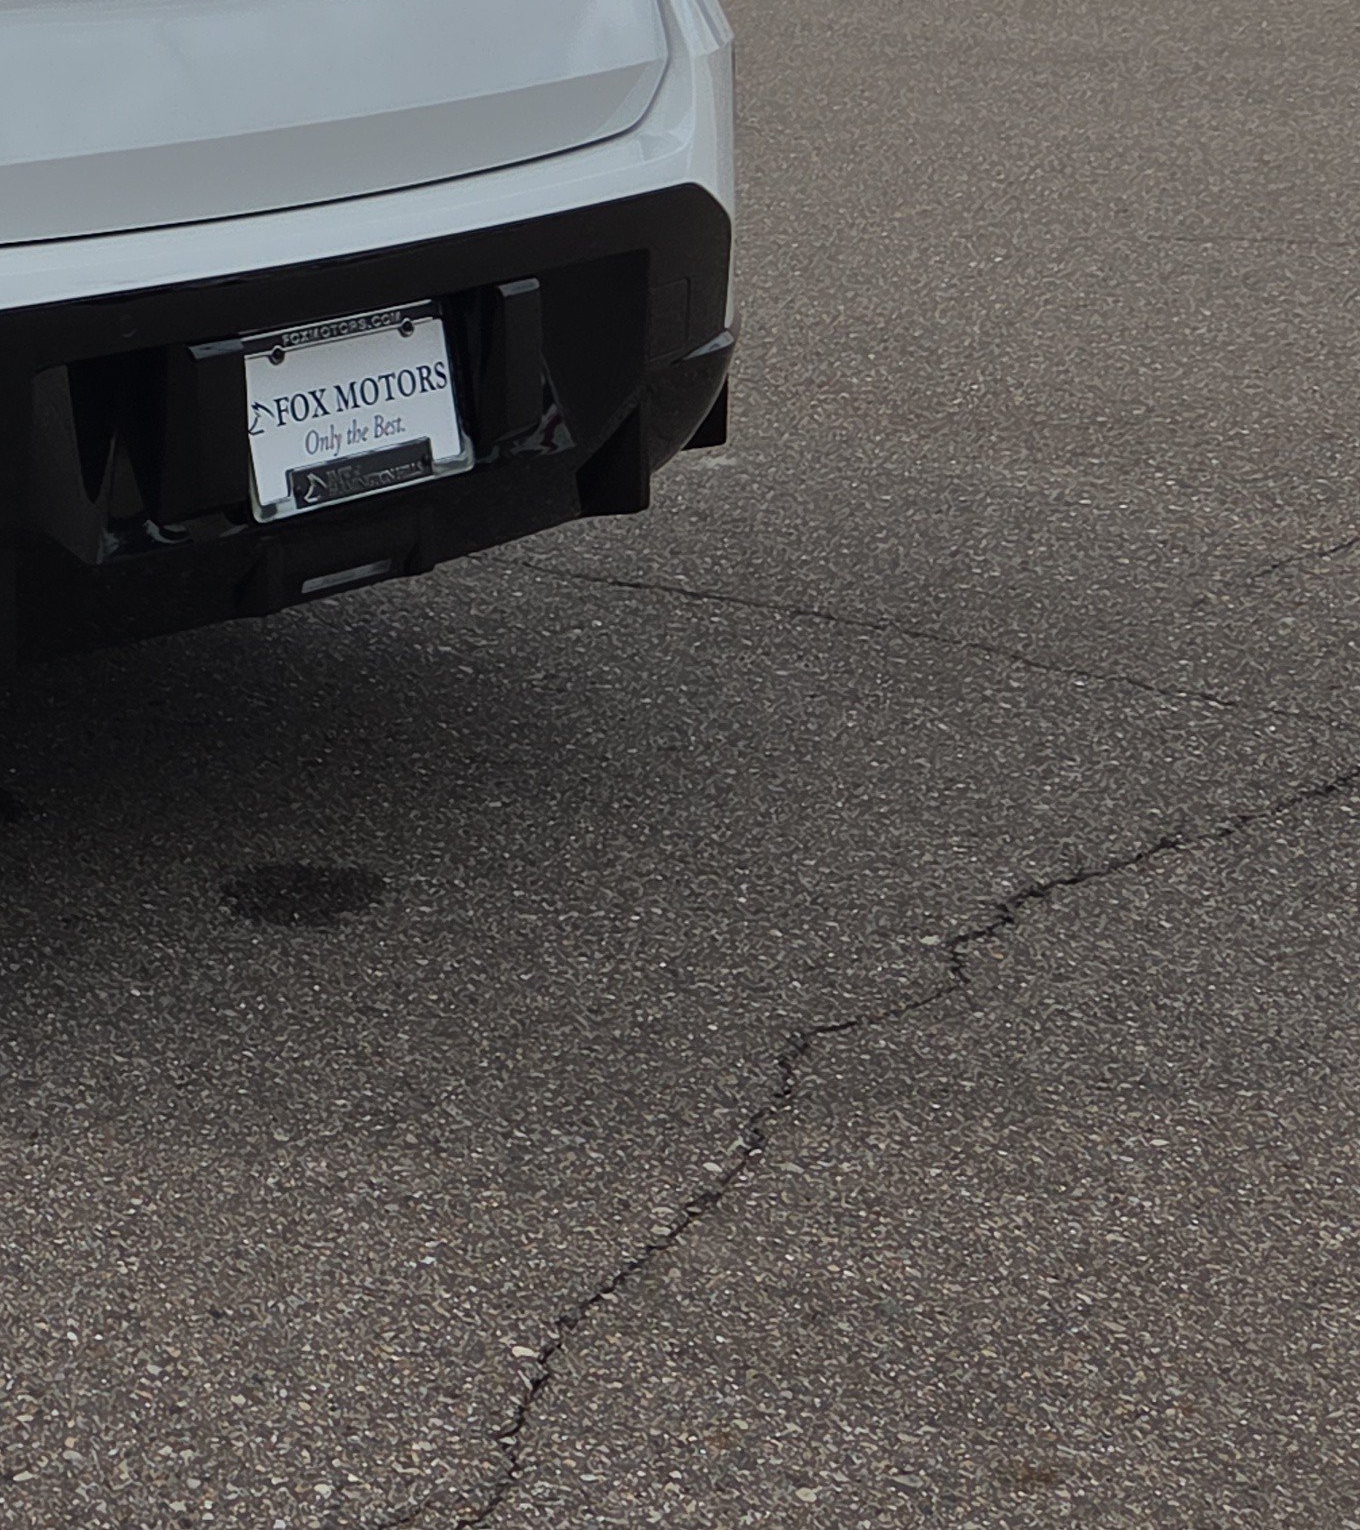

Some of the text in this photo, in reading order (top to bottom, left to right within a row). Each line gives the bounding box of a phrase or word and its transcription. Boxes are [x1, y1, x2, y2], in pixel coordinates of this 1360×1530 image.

[281, 311, 402, 346] FOXMOTORS.COM
[273, 361, 448, 427] FOX MOTORS
[305, 424, 342, 456] Only
[347, 419, 369, 445] the
